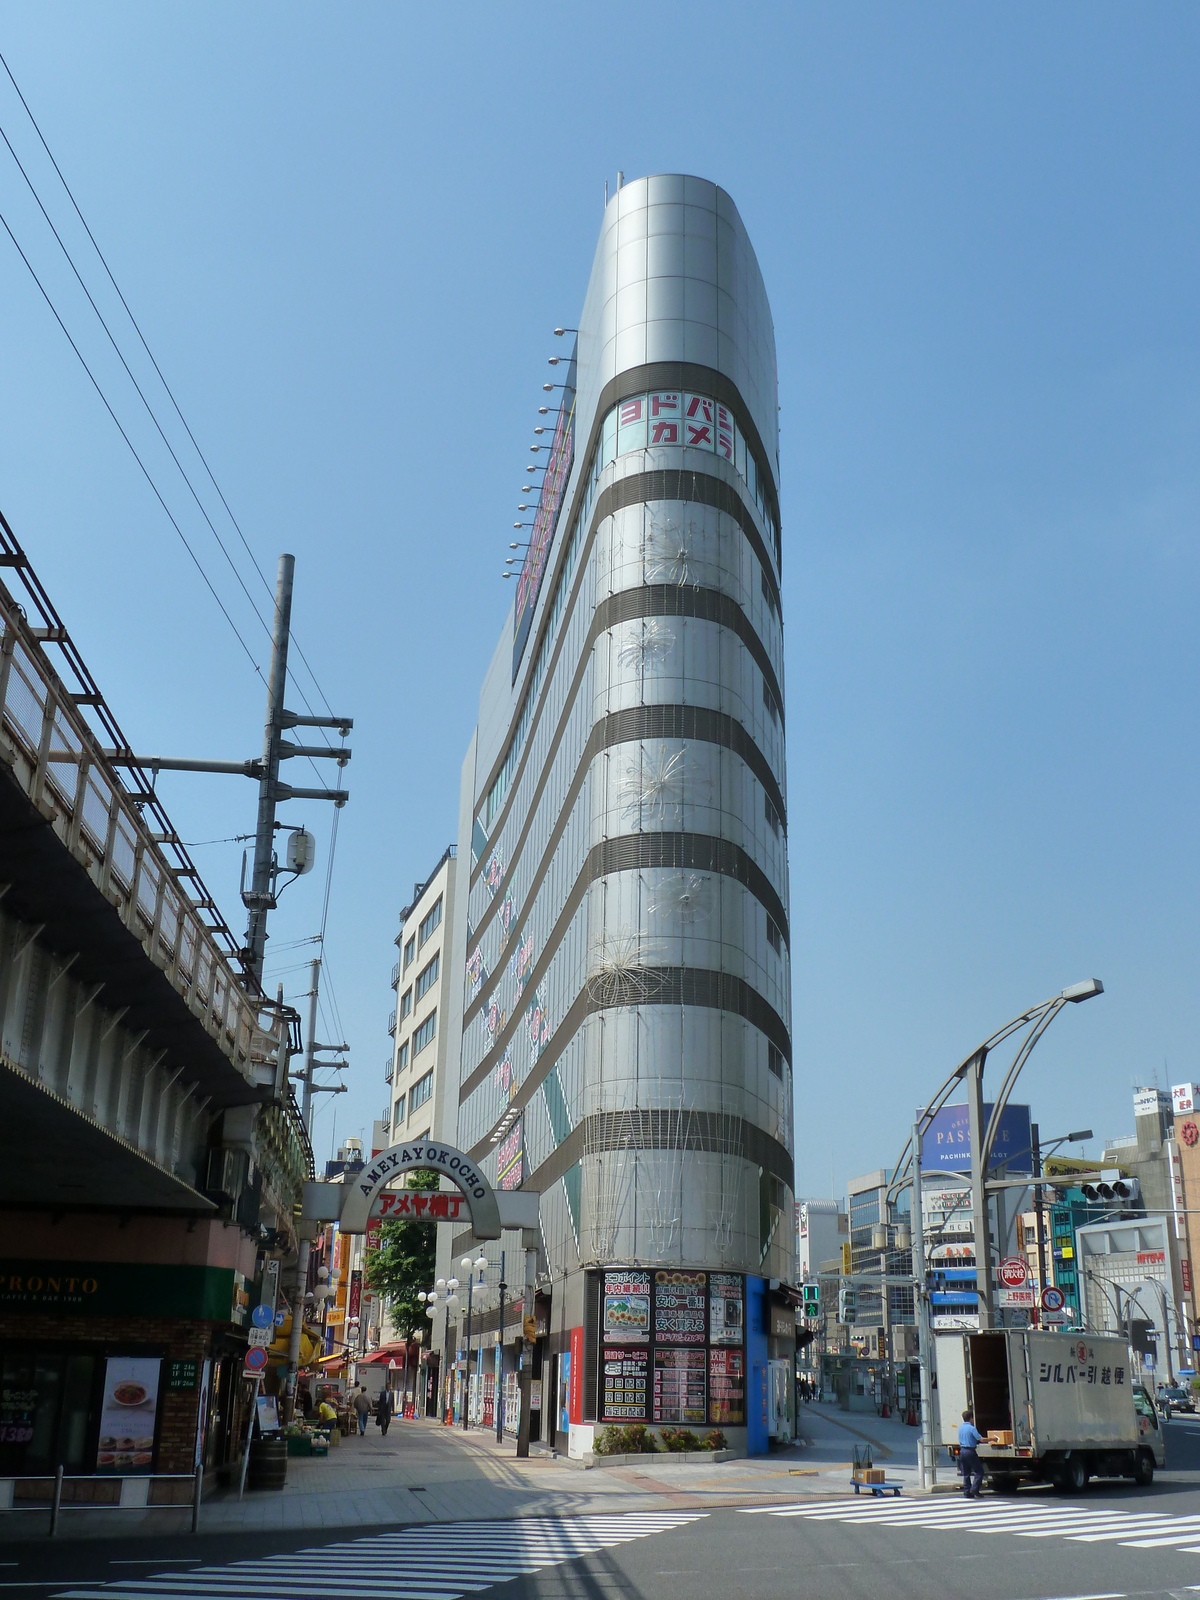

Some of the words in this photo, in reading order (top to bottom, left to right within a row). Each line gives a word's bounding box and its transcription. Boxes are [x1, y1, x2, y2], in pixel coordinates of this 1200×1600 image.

[621, 395, 732, 433] ヨドバシ
[652, 421, 732, 460] カメラ
[1173, 1088, 1186, 1099] 大和
[359, 1147, 485, 1199] AMEYAYOKOCHO
[379, 1193, 465, 1218] アメヤ横丁
[605, 1272, 650, 1284] エコポイント
[1004, 1268, 1025, 1279] 消火栓
[605, 1283, 650, 1295] 年内継続!!
[656, 1295, 705, 1309] 安心一番!!
[656, 1319, 705, 1331] 安く買える
[656, 1333, 705, 1342] ヨドバシカメラ
[656, 1351, 705, 1360] ヨドバシカメラ
[1040, 1363, 1124, 1385] シルバー引越便
[605, 1378, 646, 1390] 即日配達
